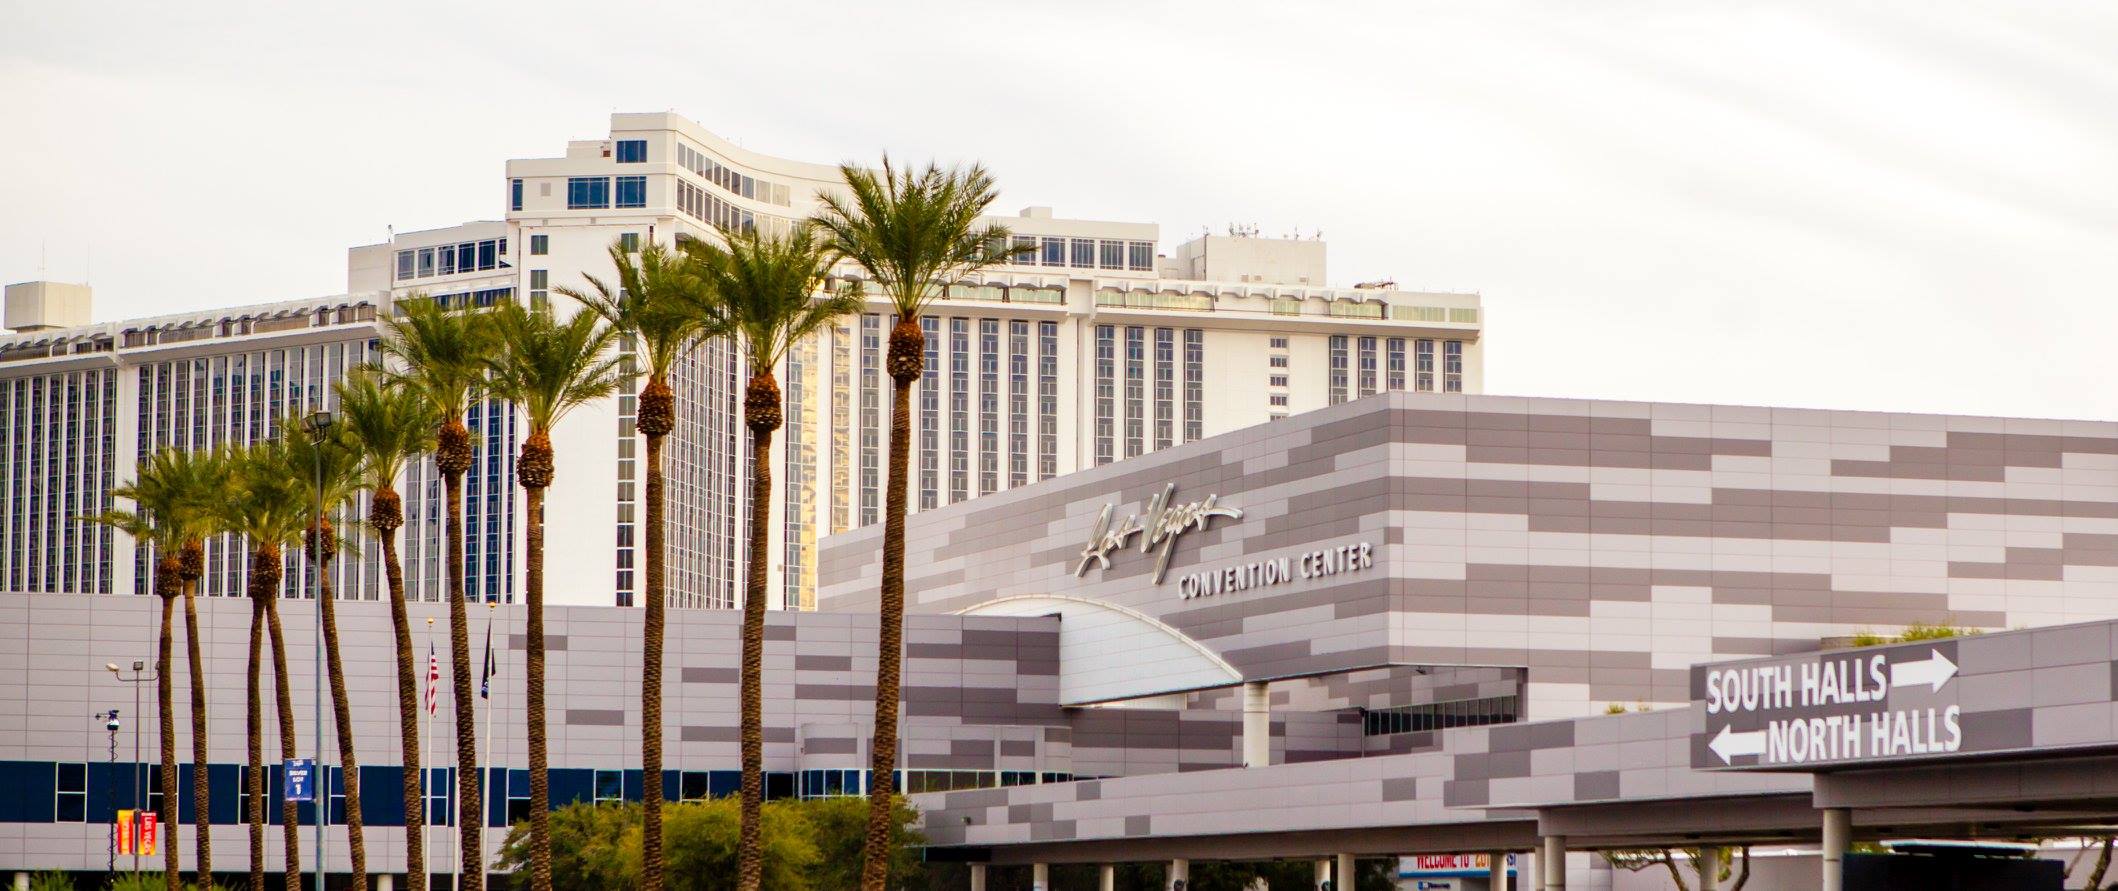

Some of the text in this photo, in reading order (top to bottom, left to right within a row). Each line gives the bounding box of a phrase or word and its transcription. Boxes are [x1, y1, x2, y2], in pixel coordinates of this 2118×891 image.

[1074, 482, 1243, 585] Las Vegas
[1178, 541, 1373, 600] CONVENTION CENTER
[1707, 655, 1887, 715] SOUTH HALLS
[1769, 704, 1962, 764] NORTH HALLS
[1416, 854, 1457, 869] WELCOME
